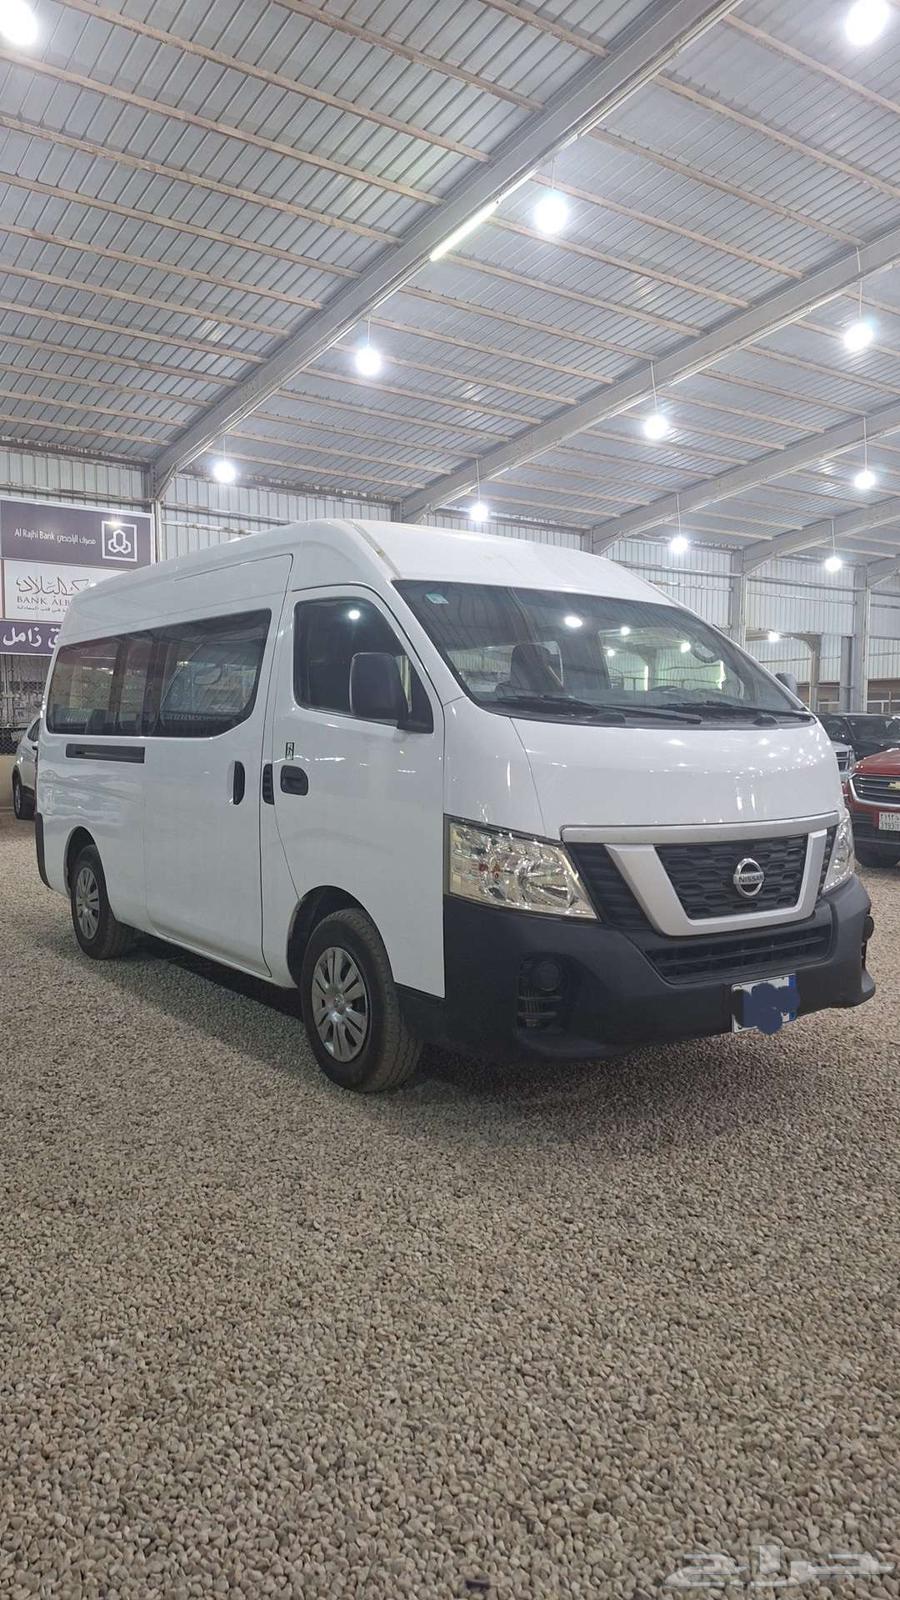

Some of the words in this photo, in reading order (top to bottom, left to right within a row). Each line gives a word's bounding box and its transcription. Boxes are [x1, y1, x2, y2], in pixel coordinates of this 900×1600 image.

[14, 528, 21, 537] Al
[22, 529, 39, 540] Rajhi
[39, 530, 55, 541] Bank
[16, 595, 47, 605] BANK
[3, 626, 42, 647] زامل
[739, 873, 763, 883] NISSAN
